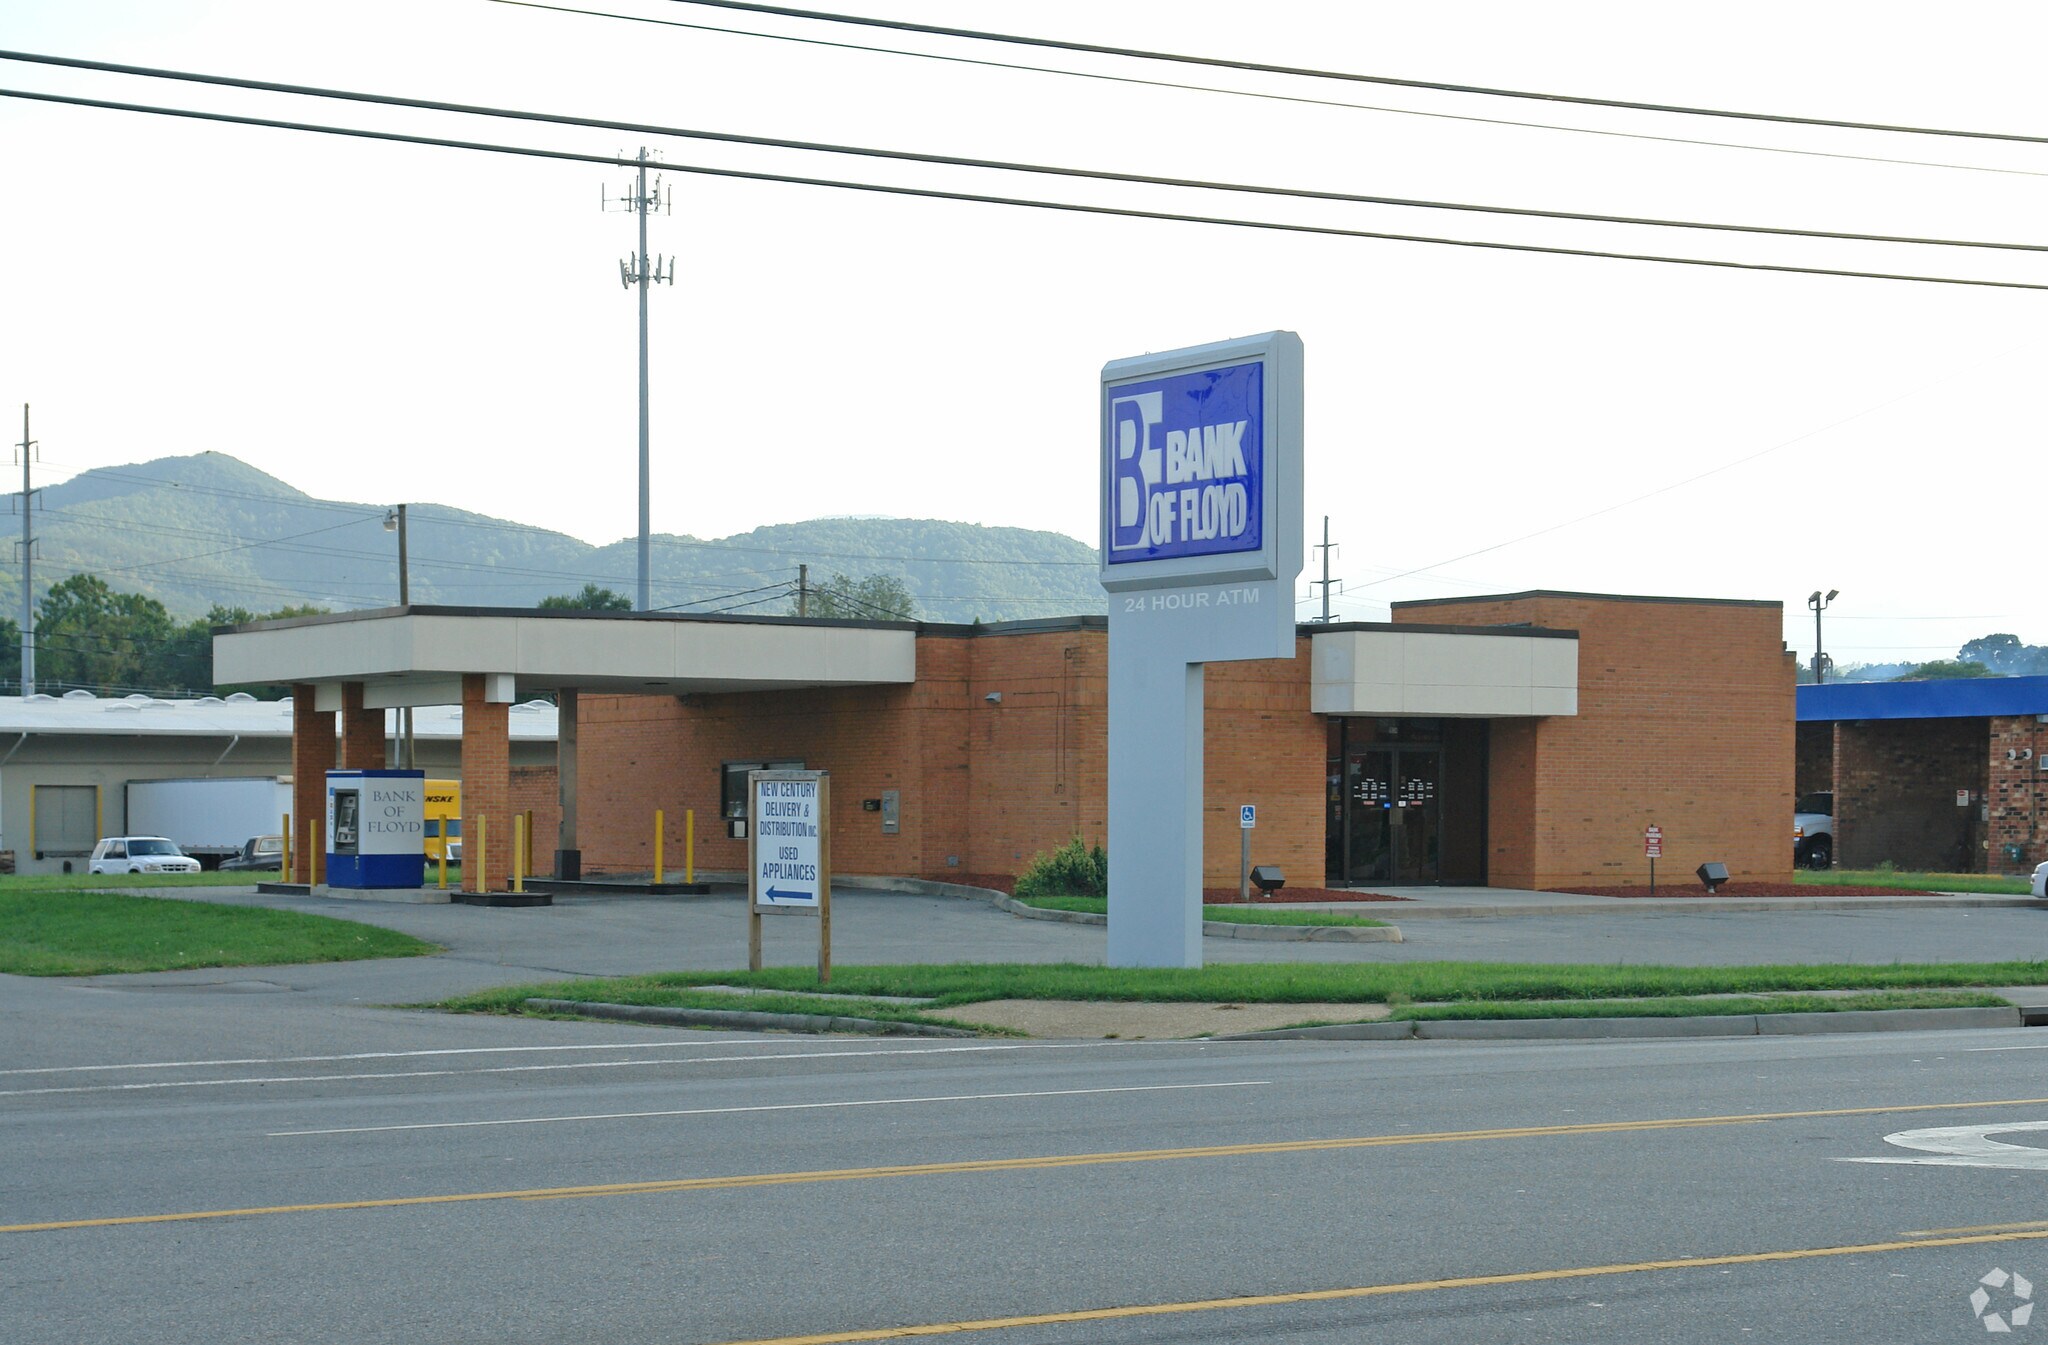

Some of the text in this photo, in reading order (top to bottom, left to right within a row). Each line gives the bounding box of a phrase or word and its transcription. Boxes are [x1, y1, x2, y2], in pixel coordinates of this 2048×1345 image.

[1166, 420, 1248, 484] BANK
[1149, 483, 1248, 545] OF FLOYD
[1124, 587, 1260, 613] 24 HOUR ATM
[373, 790, 416, 802] BANK
[761, 782, 816, 798] NEW CENTURY
[424, 795, 455, 803] NSKE
[383, 806, 405, 817] OF
[765, 802, 810, 818] DELIVERY &
[368, 821, 421, 833] FLOYD
[760, 821, 807, 837] DISTRIBUTION
[779, 846, 799, 860] USED
[762, 863, 816, 881] APPLIANCES
